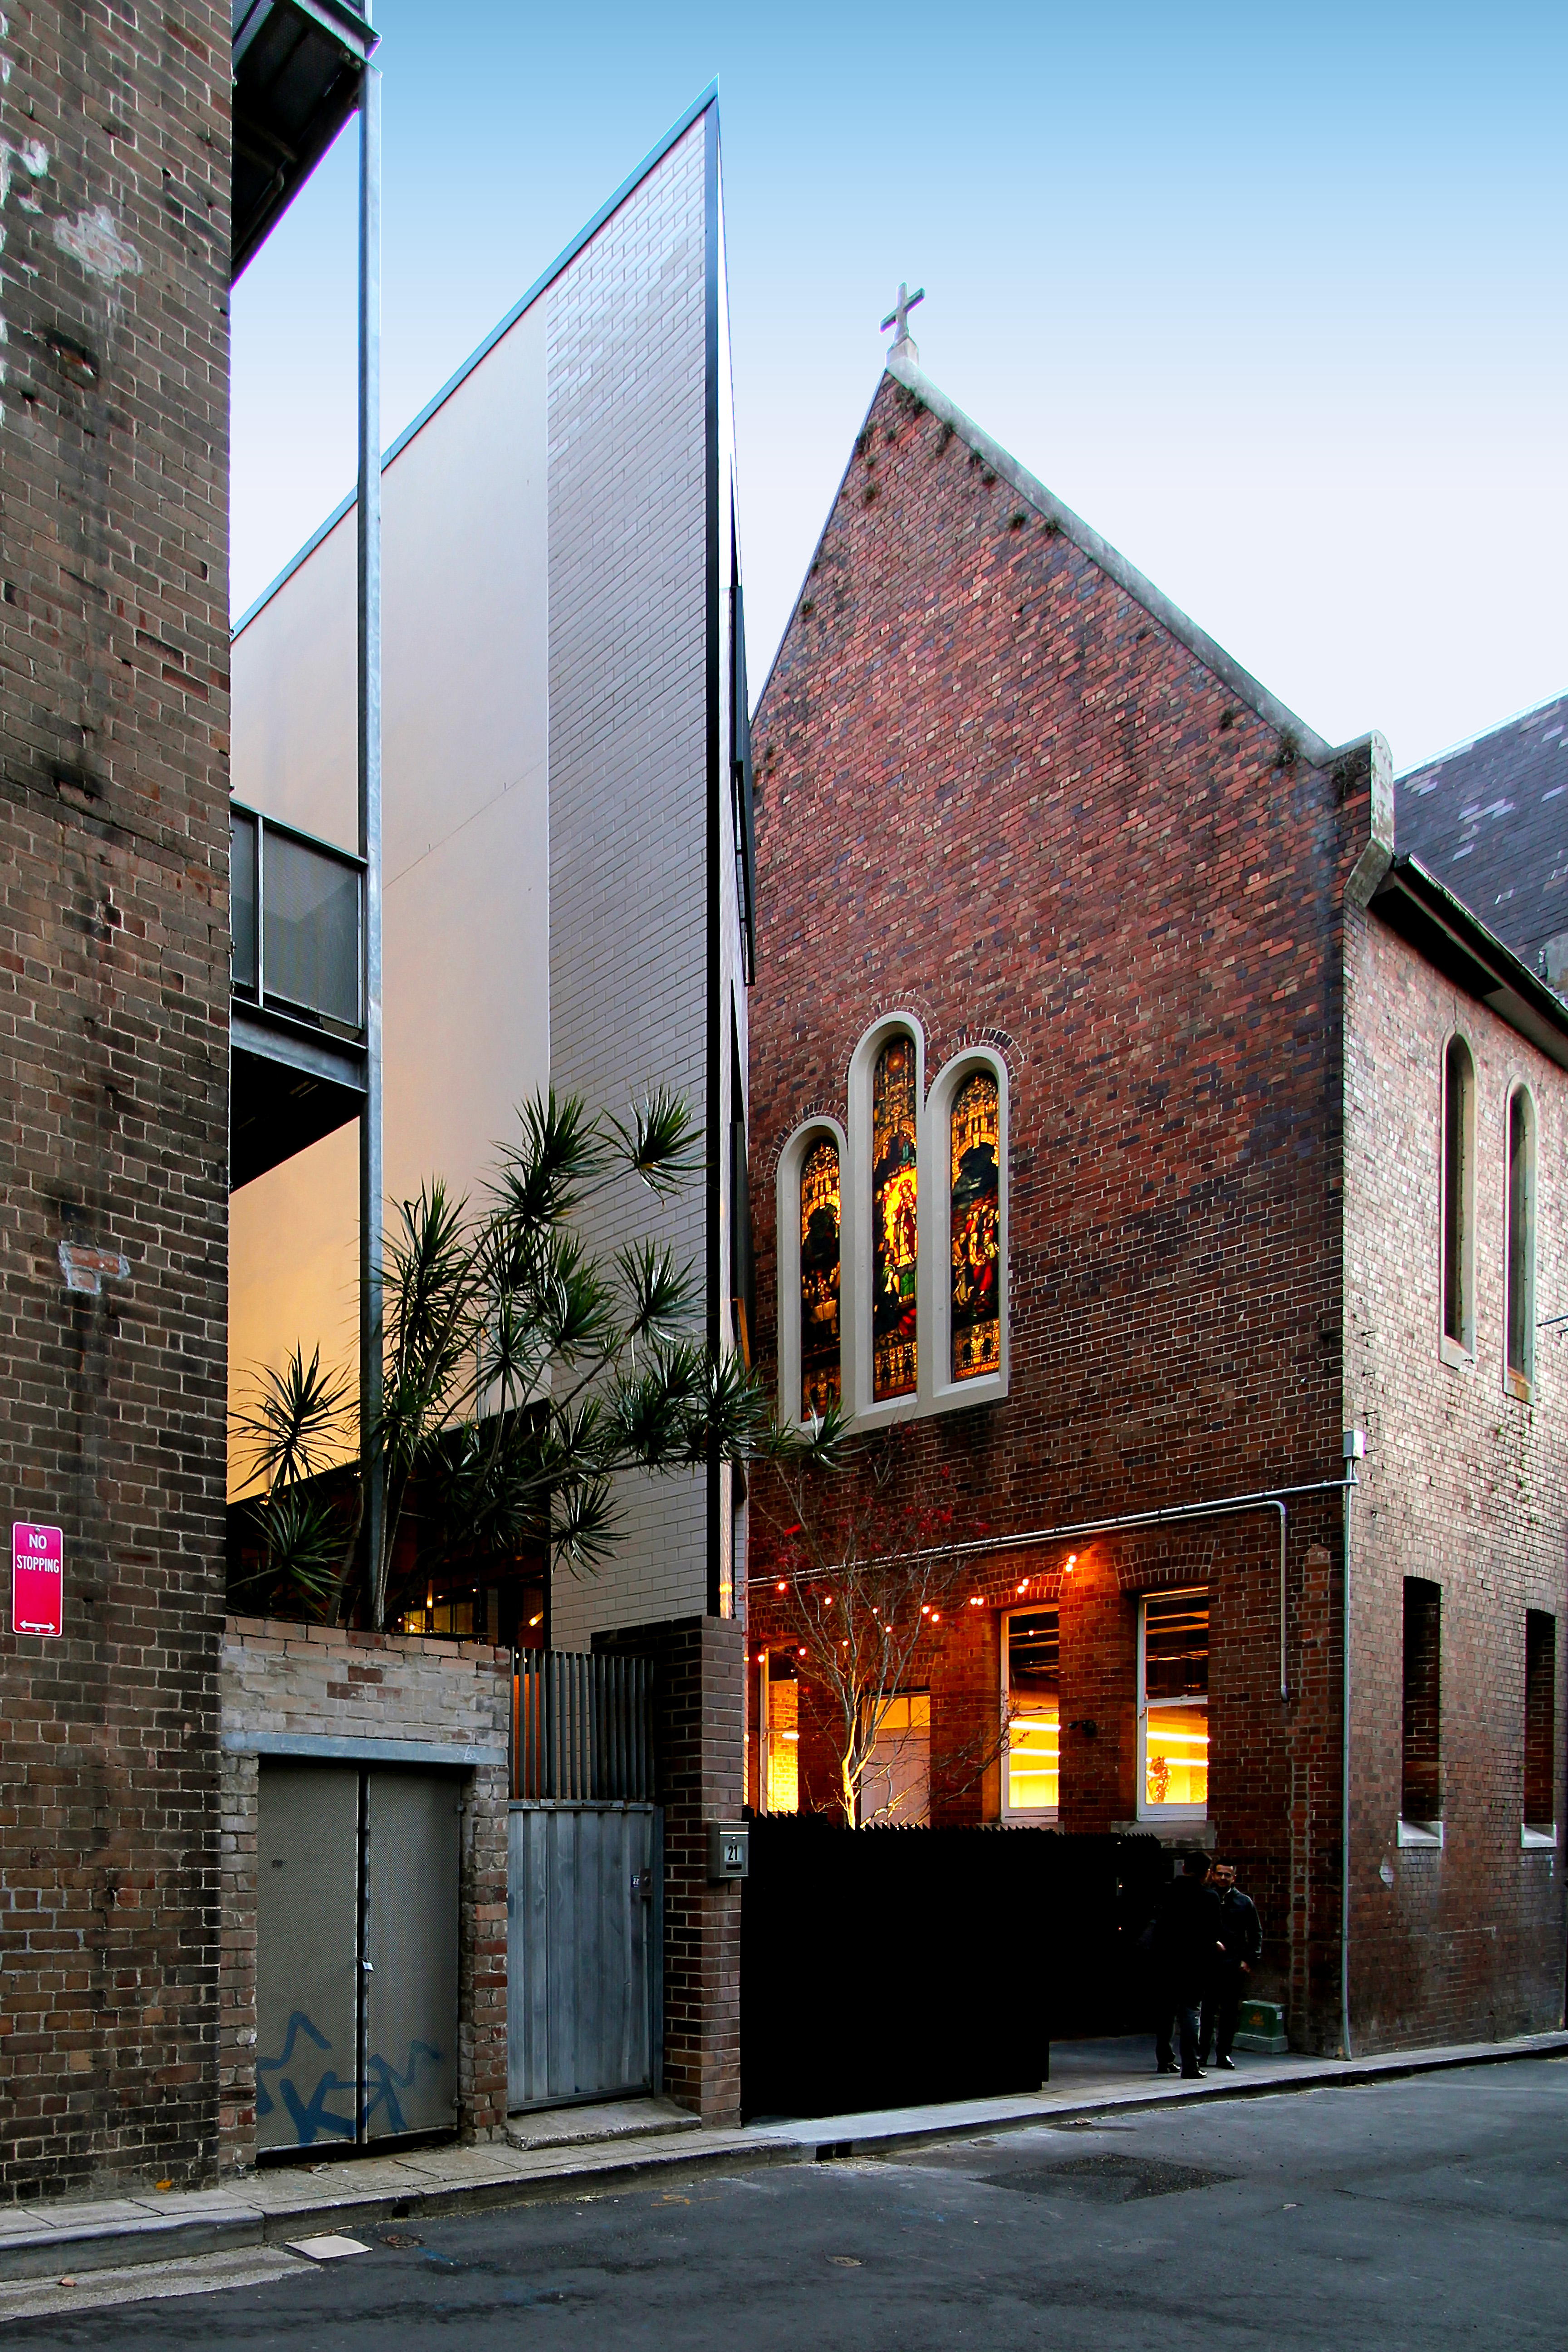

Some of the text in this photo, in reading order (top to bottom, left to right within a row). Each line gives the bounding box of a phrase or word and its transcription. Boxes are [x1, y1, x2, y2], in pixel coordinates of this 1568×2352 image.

[29, 1534, 47, 1549] NO
[17, 1555, 59, 1573] STOPPING
[728, 1845, 738, 1861] 21
